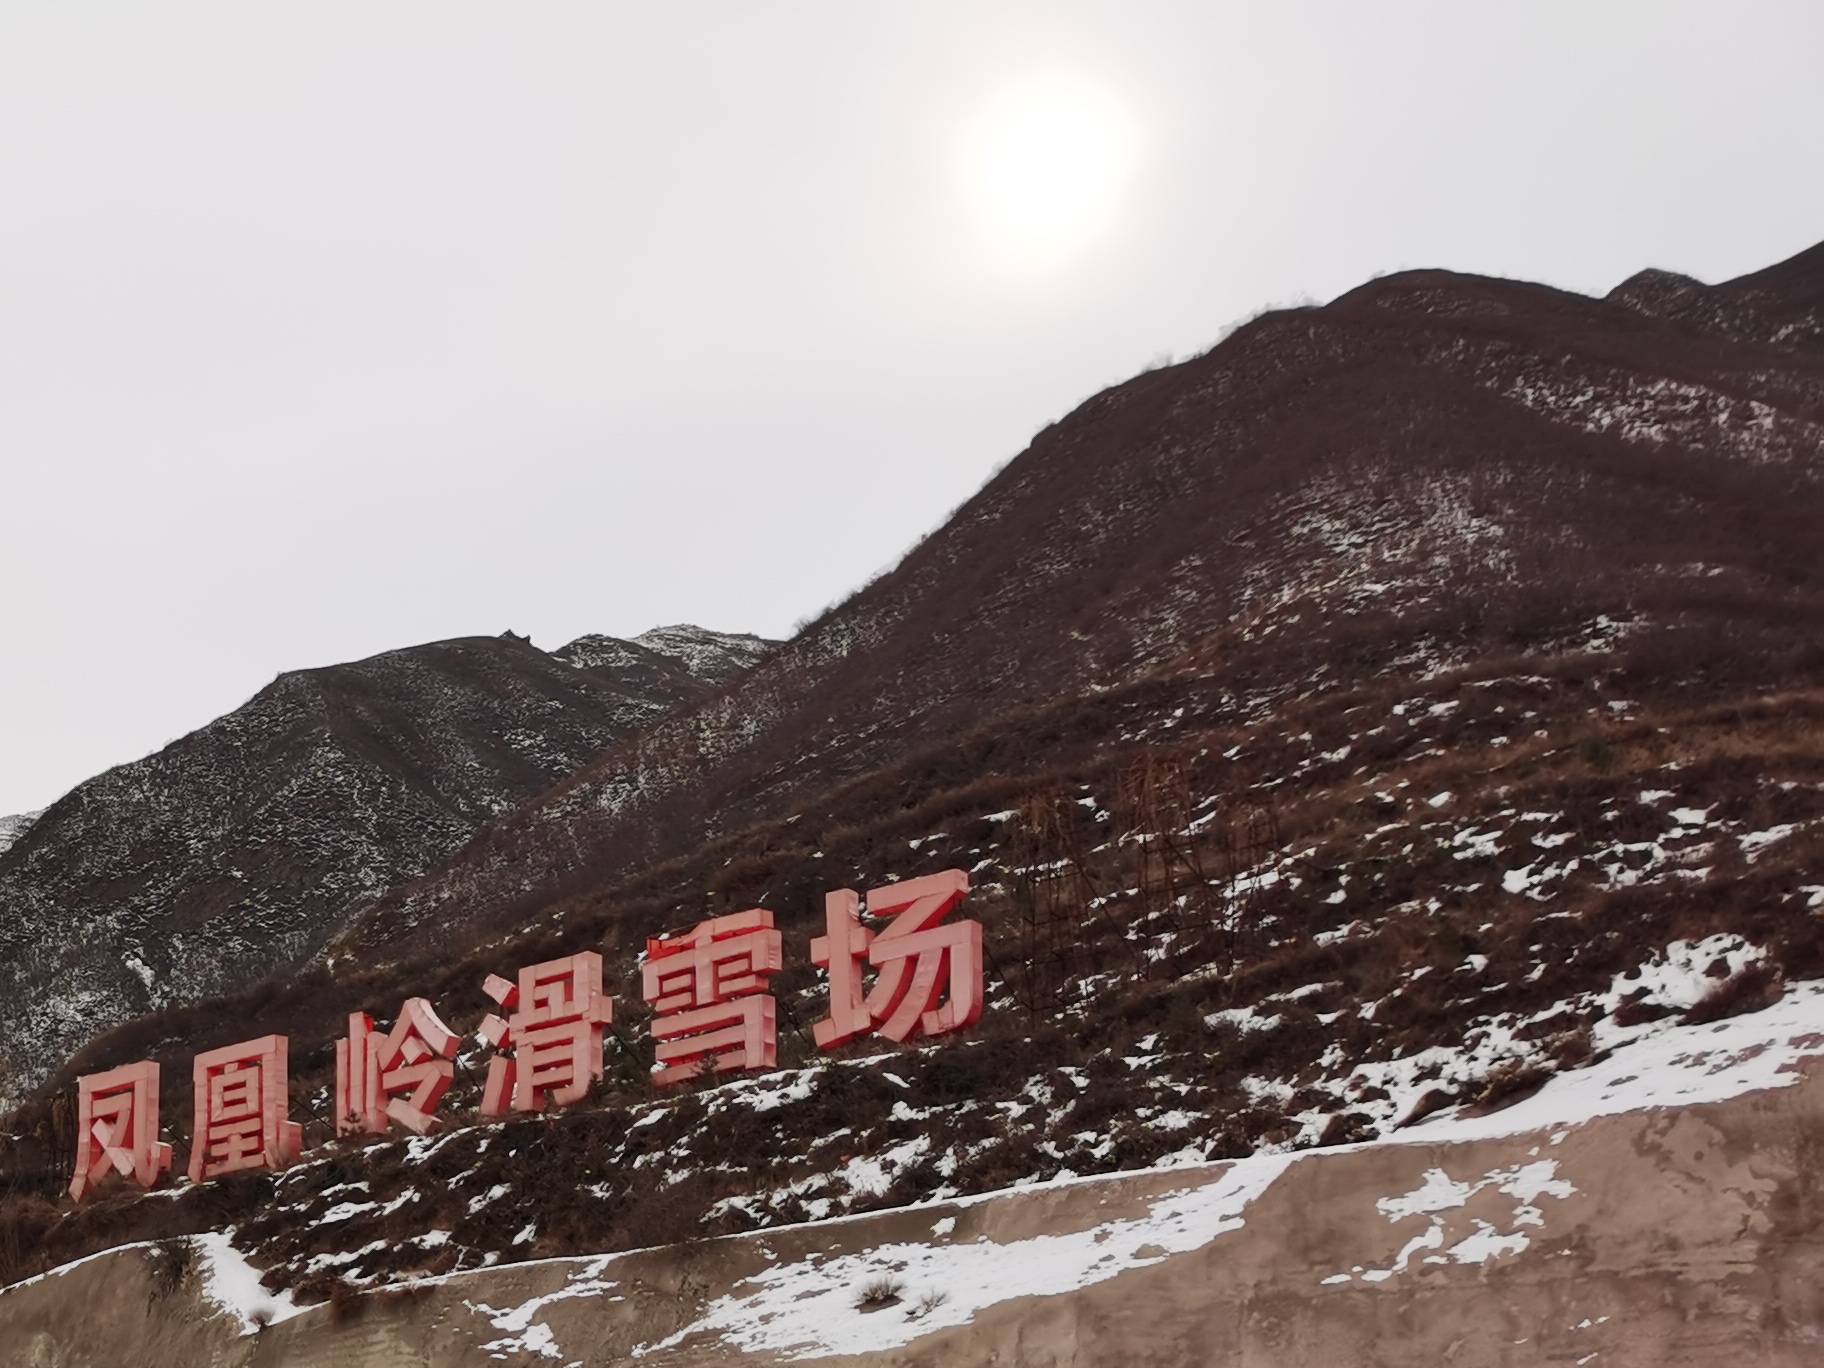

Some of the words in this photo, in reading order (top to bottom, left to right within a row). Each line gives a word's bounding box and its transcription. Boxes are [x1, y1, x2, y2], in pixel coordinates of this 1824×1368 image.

[70, 868, 984, 1201] 凤凰岭滑雪场
